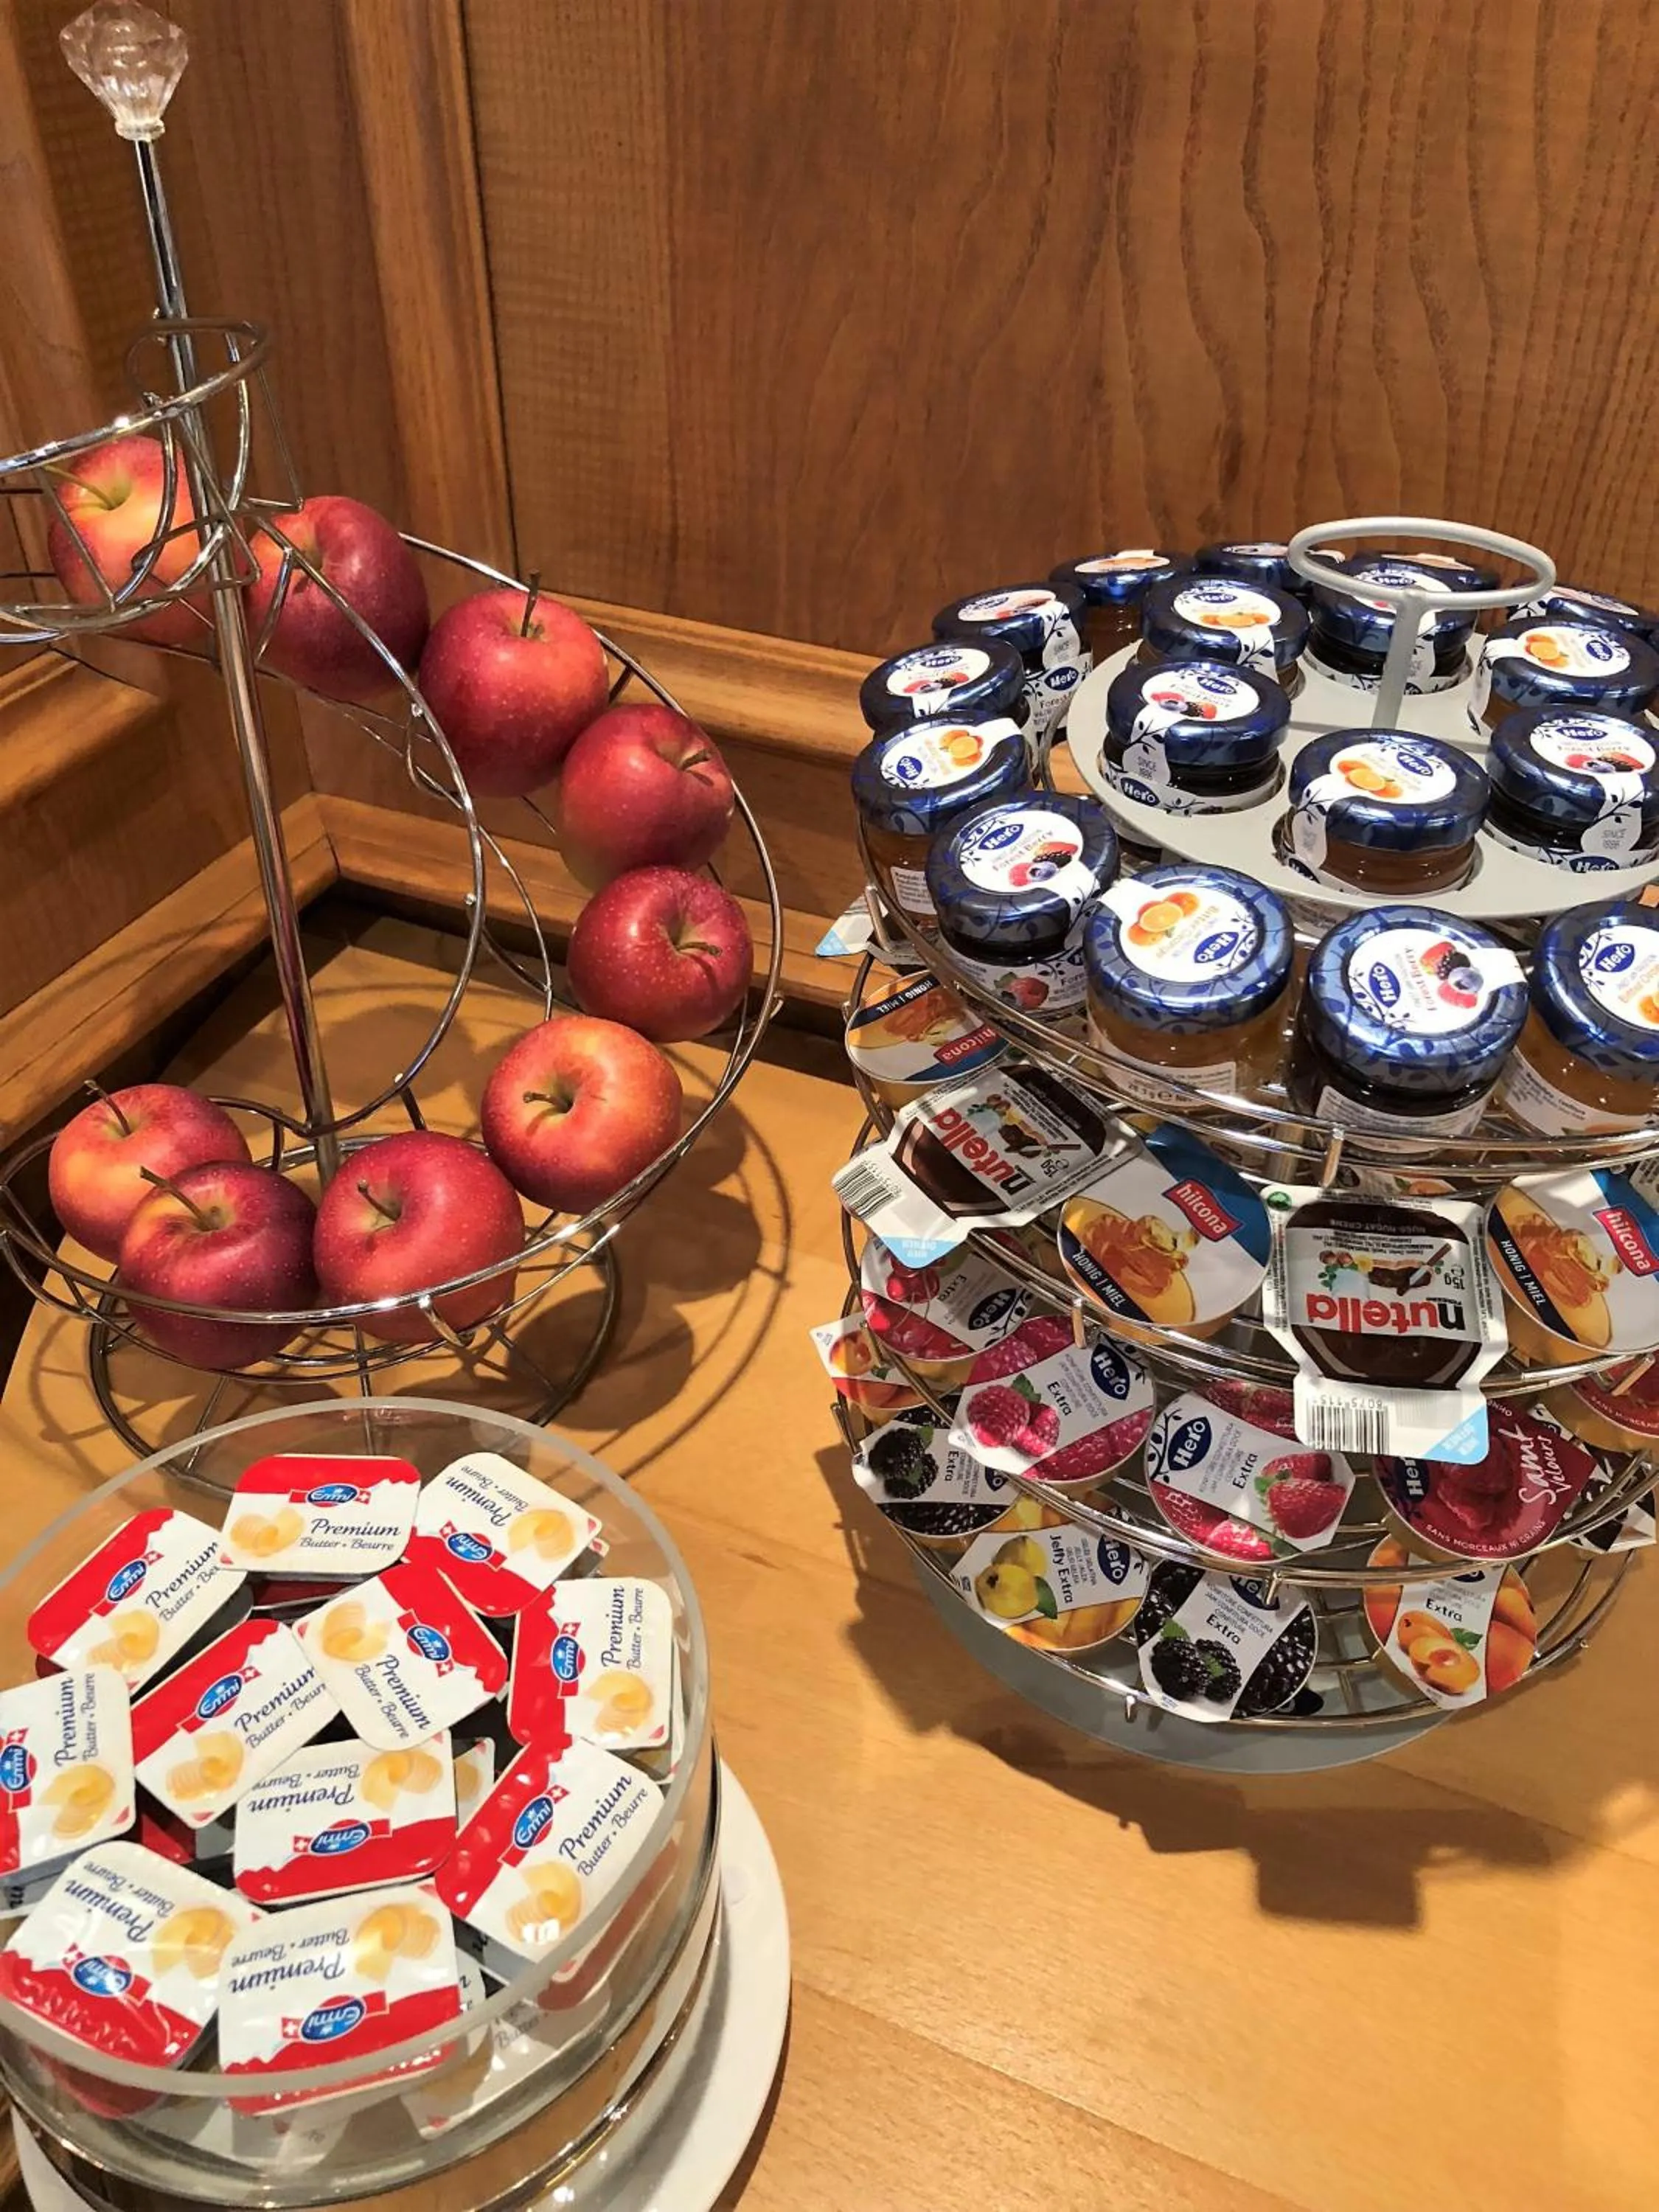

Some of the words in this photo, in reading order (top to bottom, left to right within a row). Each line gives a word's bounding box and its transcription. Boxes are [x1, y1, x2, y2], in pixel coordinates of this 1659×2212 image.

[1200, 593, 1233, 602] Hero
[1050, 669, 1076, 688] Hero
[1202, 677, 1233, 695] Hero
[1563, 728, 1603, 738] Hero
[897, 757, 922, 779] Hero
[1399, 754, 1432, 776] Hero
[1123, 782, 1157, 804] Hero
[984, 824, 1020, 849] Hero
[992, 850, 1023, 872] Forest
[1023, 830, 1054, 852] Berry
[1197, 933, 1236, 963] Hero
[1599, 945, 1632, 972] Hero
[1371, 965, 1400, 1002] Hero
[942, 1028, 996, 1060] hilcona
[931, 1107, 1037, 1197] nutella
[1177, 1183, 1227, 1234] hilcona
[1605, 1211, 1649, 1271] hilcona
[936, 1276, 967, 1302] Extra
[1072, 1250, 1098, 1279] HONIG
[1103, 1284, 1127, 1307] MIEL
[1444, 1272, 1466, 1290] 15g
[1500, 1239, 1520, 1267] HONIG
[1526, 1277, 1545, 1305] MIEL
[973, 1290, 1017, 1328] Hero
[1306, 1293, 1466, 1335] nutella
[1093, 1352, 1127, 1395] Hero
[1047, 1381, 1071, 1416] Extra
[1172, 1420, 1208, 1470] Hero
[944, 1450, 959, 1481] Extra
[1232, 1453, 1259, 1489] Extra
[1404, 1456, 1424, 1496] Her
[310, 1487, 355, 1503] Emmi
[444, 1475, 515, 1528] Premium
[459, 1464, 495, 1490] Beurre
[497, 1486, 529, 1513] Butter
[299, 1537, 339, 1548] Butter
[351, 1538, 394, 1551] Beurre
[311, 1517, 401, 1537] Premium
[1426, 1523, 1450, 1543] SANS
[1453, 1538, 1508, 1553] MORCEAUX
[1520, 1520, 1546, 1544] GRAINS
[452, 1532, 490, 1560] Emmi
[108, 1561, 147, 1600] Emmi
[1057, 1568, 1074, 1604] Extra
[159, 1585, 204, 1622] Butter
[628, 1587, 644, 1624] Beurre
[1425, 1597, 1464, 1623] Extra
[412, 1627, 448, 1661] Emmi
[601, 1585, 625, 1668] Premium
[1206, 1613, 1240, 1645] Extra
[557, 1638, 578, 1680] Emmi
[625, 1631, 643, 1670] Butter
[80, 1673, 96, 1715] Beurre
[199, 1677, 241, 1718] Emmi
[354, 1664, 380, 1703] Butter
[380, 1700, 410, 1740] Beurre
[376, 1653, 432, 1731] Premium
[54, 1676, 74, 1767] Premium
[246, 1713, 288, 1750] Butter
[290, 1683, 327, 1719] Beurr
[82, 1720, 98, 1763] Butter
[7, 1747, 25, 1790] Emmi
[312, 1764, 361, 1783] Butter
[246, 1783, 355, 1815] Premium
[557, 1773, 633, 1860] Premium
[313, 1829, 368, 1851] Emmi
[516, 1801, 553, 1846] Emmi
[577, 1836, 614, 1877] Butter
[612, 1788, 650, 1829] Beurre
[83, 1860, 132, 1892] Beurre
[133, 1886, 176, 1917] Butter
[63, 1879, 154, 1944] Premium
[232, 1941, 287, 1968] Beurre
[297, 1927, 351, 1947] Butter
[229, 1953, 347, 1994] Premium
[302, 2003, 363, 2035] Emmi
